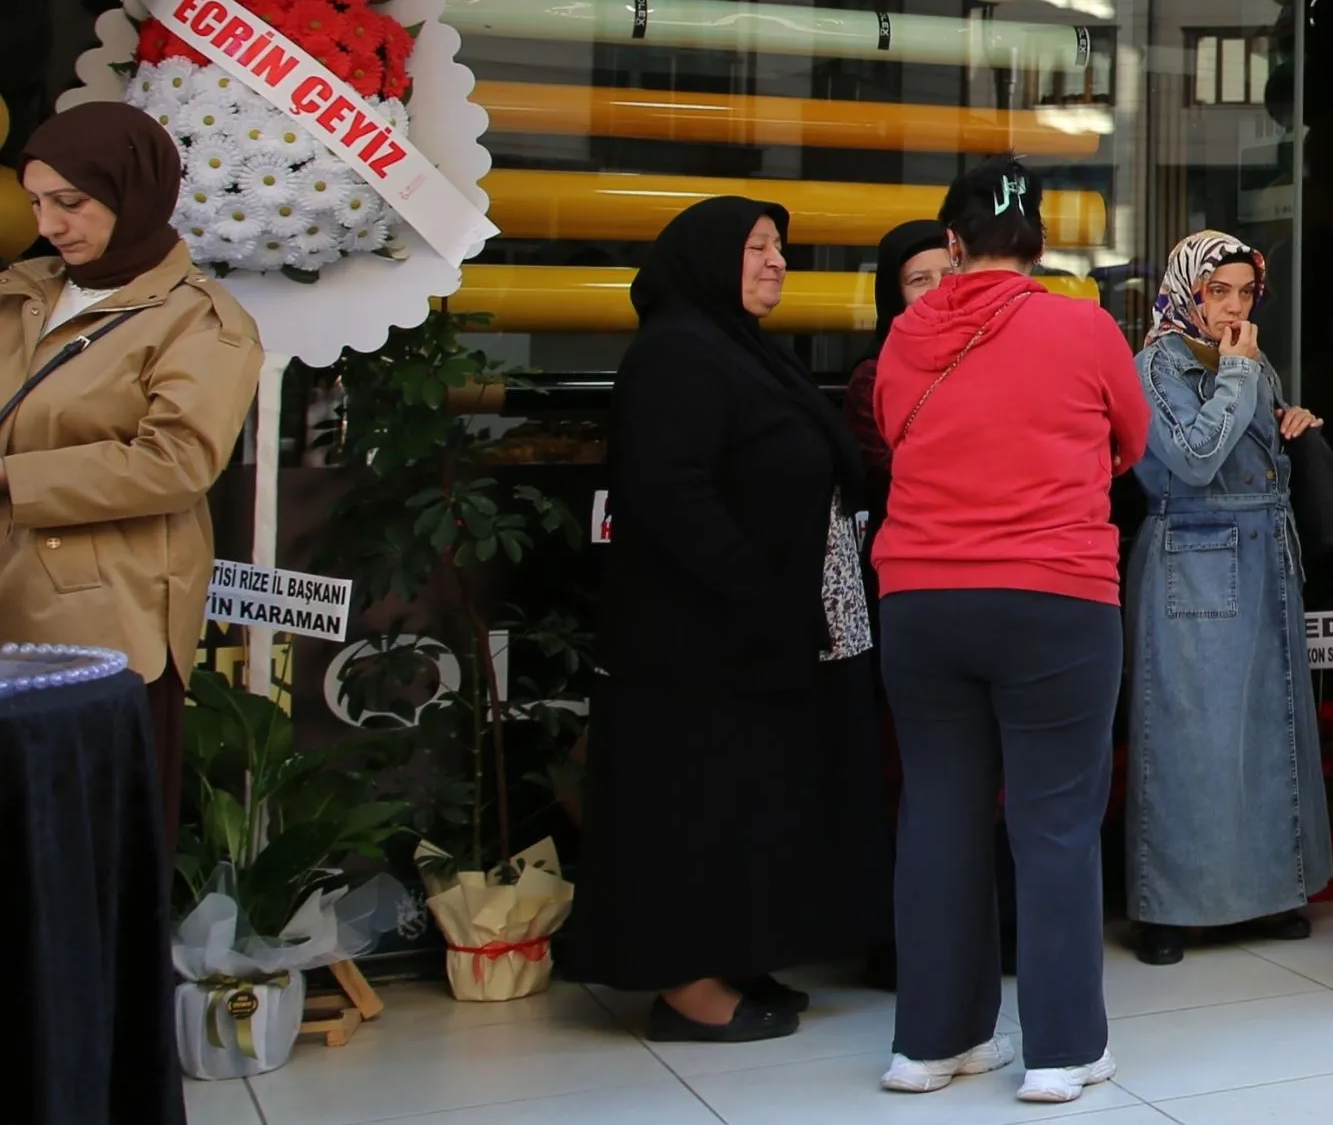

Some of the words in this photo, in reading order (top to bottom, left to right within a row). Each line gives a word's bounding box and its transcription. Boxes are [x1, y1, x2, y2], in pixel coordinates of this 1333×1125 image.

[288, 75, 408, 180] ÇEYİZ
[239, 566, 269, 593] RİZE
[272, 570, 283, 596] İL
[287, 577, 347, 605] BAŞKANI
[206, 592, 232, 616] İN
[240, 600, 341, 635] KARAMAN
